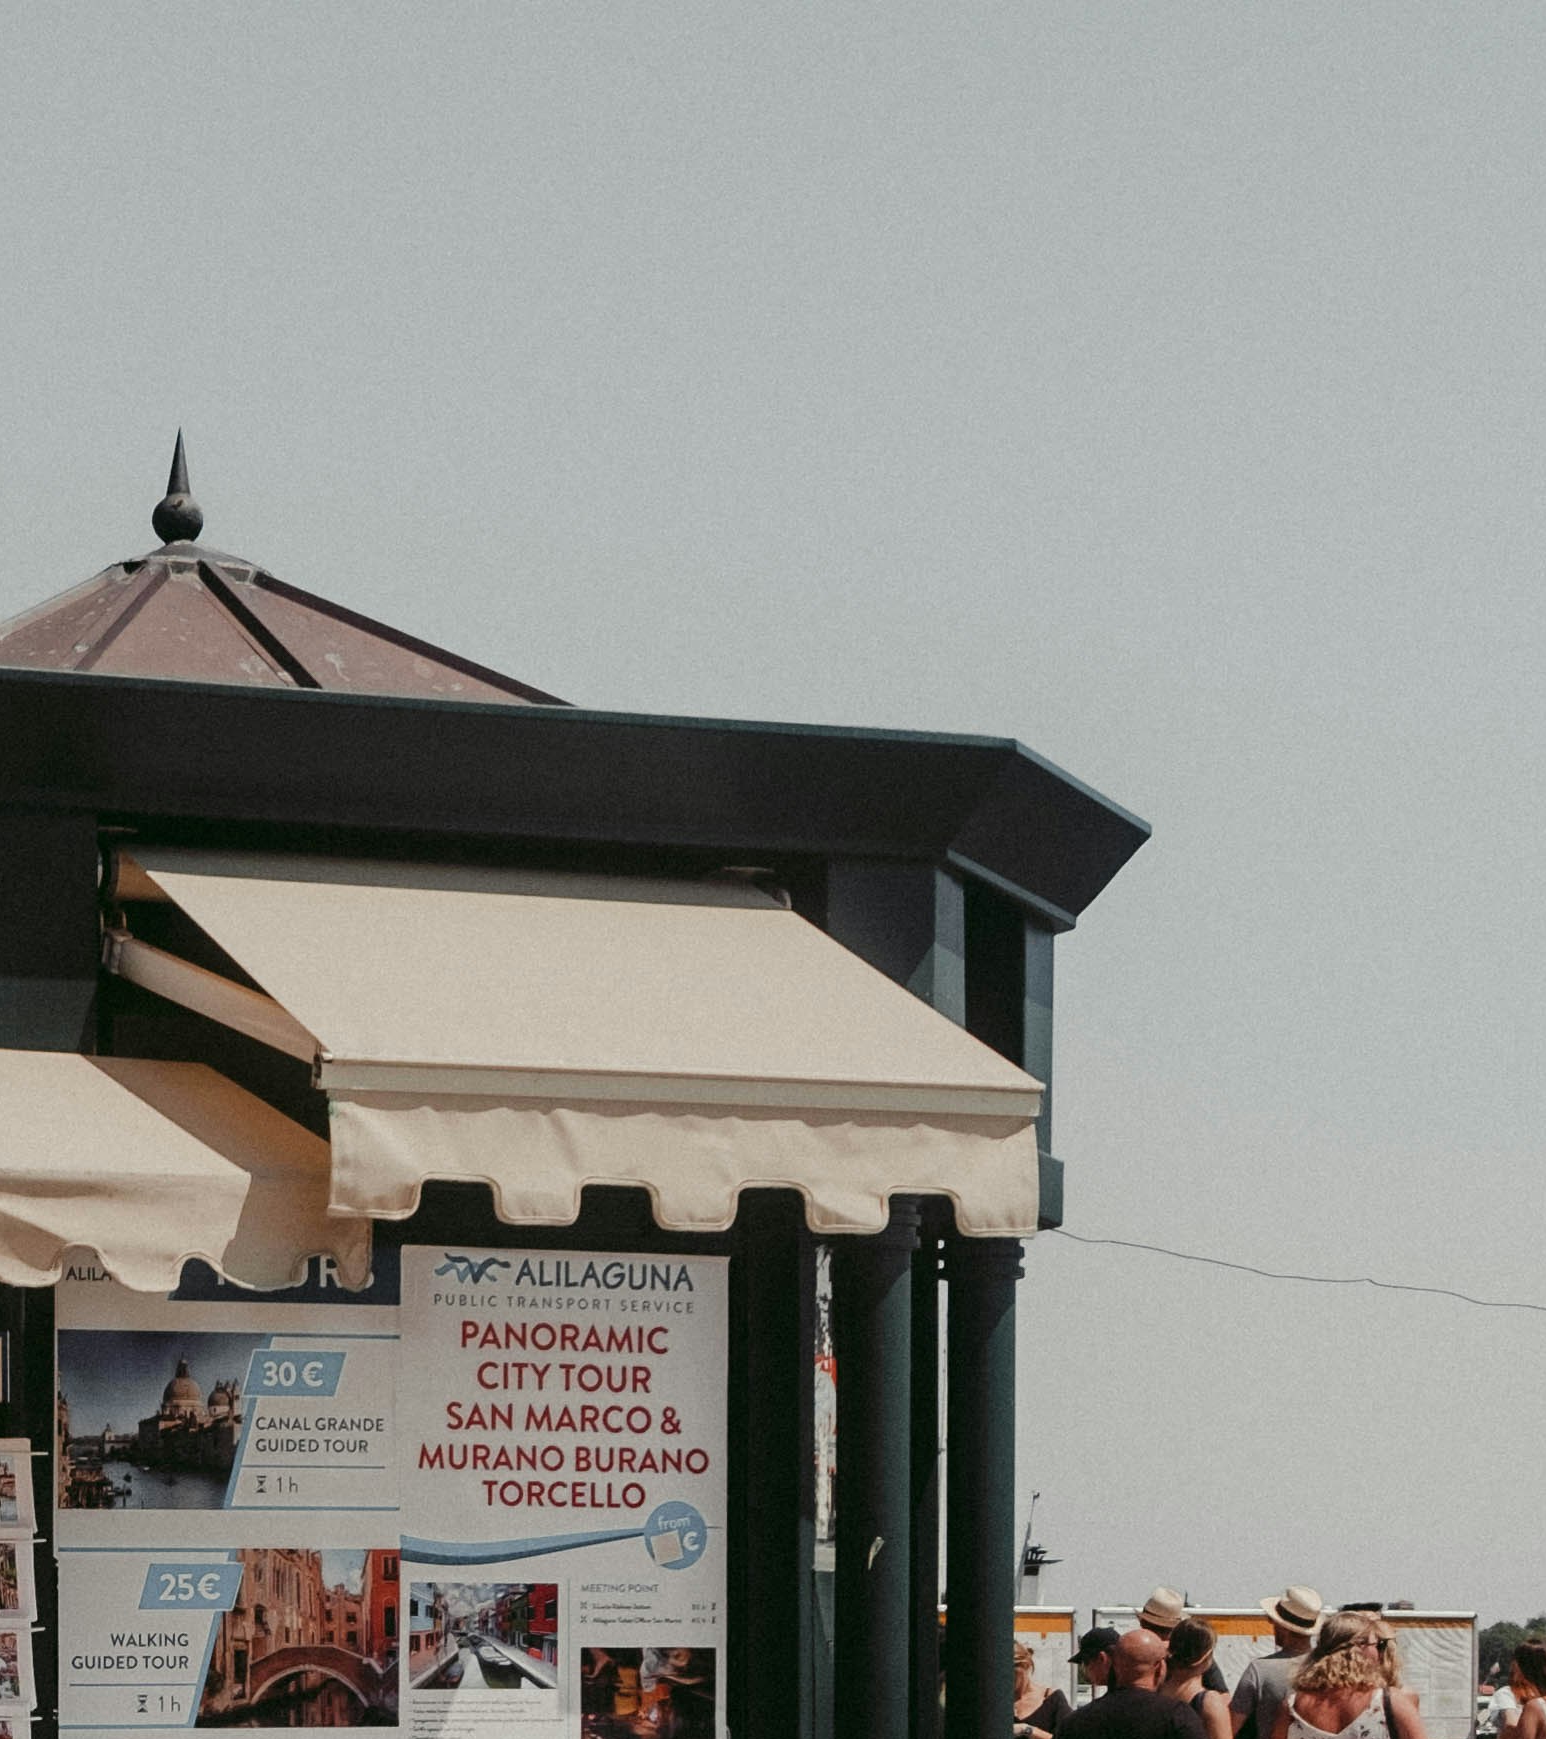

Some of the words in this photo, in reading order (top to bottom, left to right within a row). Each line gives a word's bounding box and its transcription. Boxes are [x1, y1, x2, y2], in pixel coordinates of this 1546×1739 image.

[65, 1266, 112, 1281] ALILA
[515, 1259, 694, 1292] ALILAGUNA
[433, 1293, 497, 1309] PUBLIC
[506, 1296, 611, 1312] TRANSPORT
[619, 1299, 695, 1314] SERVICE
[460, 1320, 669, 1356] PANORAMIC
[477, 1362, 552, 1393] CITY
[558, 1362, 652, 1394] TOUR
[256, 1416, 310, 1432] CANAL
[314, 1418, 385, 1434] GRANDE
[446, 1402, 511, 1432] SAN
[524, 1405, 652, 1435] MARCO
[660, 1406, 682, 1435] &
[256, 1437, 317, 1454] GUIDED
[322, 1439, 369, 1454] TOUR
[418, 1444, 565, 1473] MURANO
[574, 1446, 710, 1475] BURANO
[483, 1479, 646, 1510] TORCELLO
[658, 1516, 691, 1530] from
[159, 1572, 221, 1601] 25€
[581, 1584, 625, 1593] MEETING
[628, 1584, 659, 1593] POINT
[109, 1631, 189, 1649] WALKING
[71, 1654, 136, 1671] GUIDED
[140, 1654, 189, 1671] TOUR
